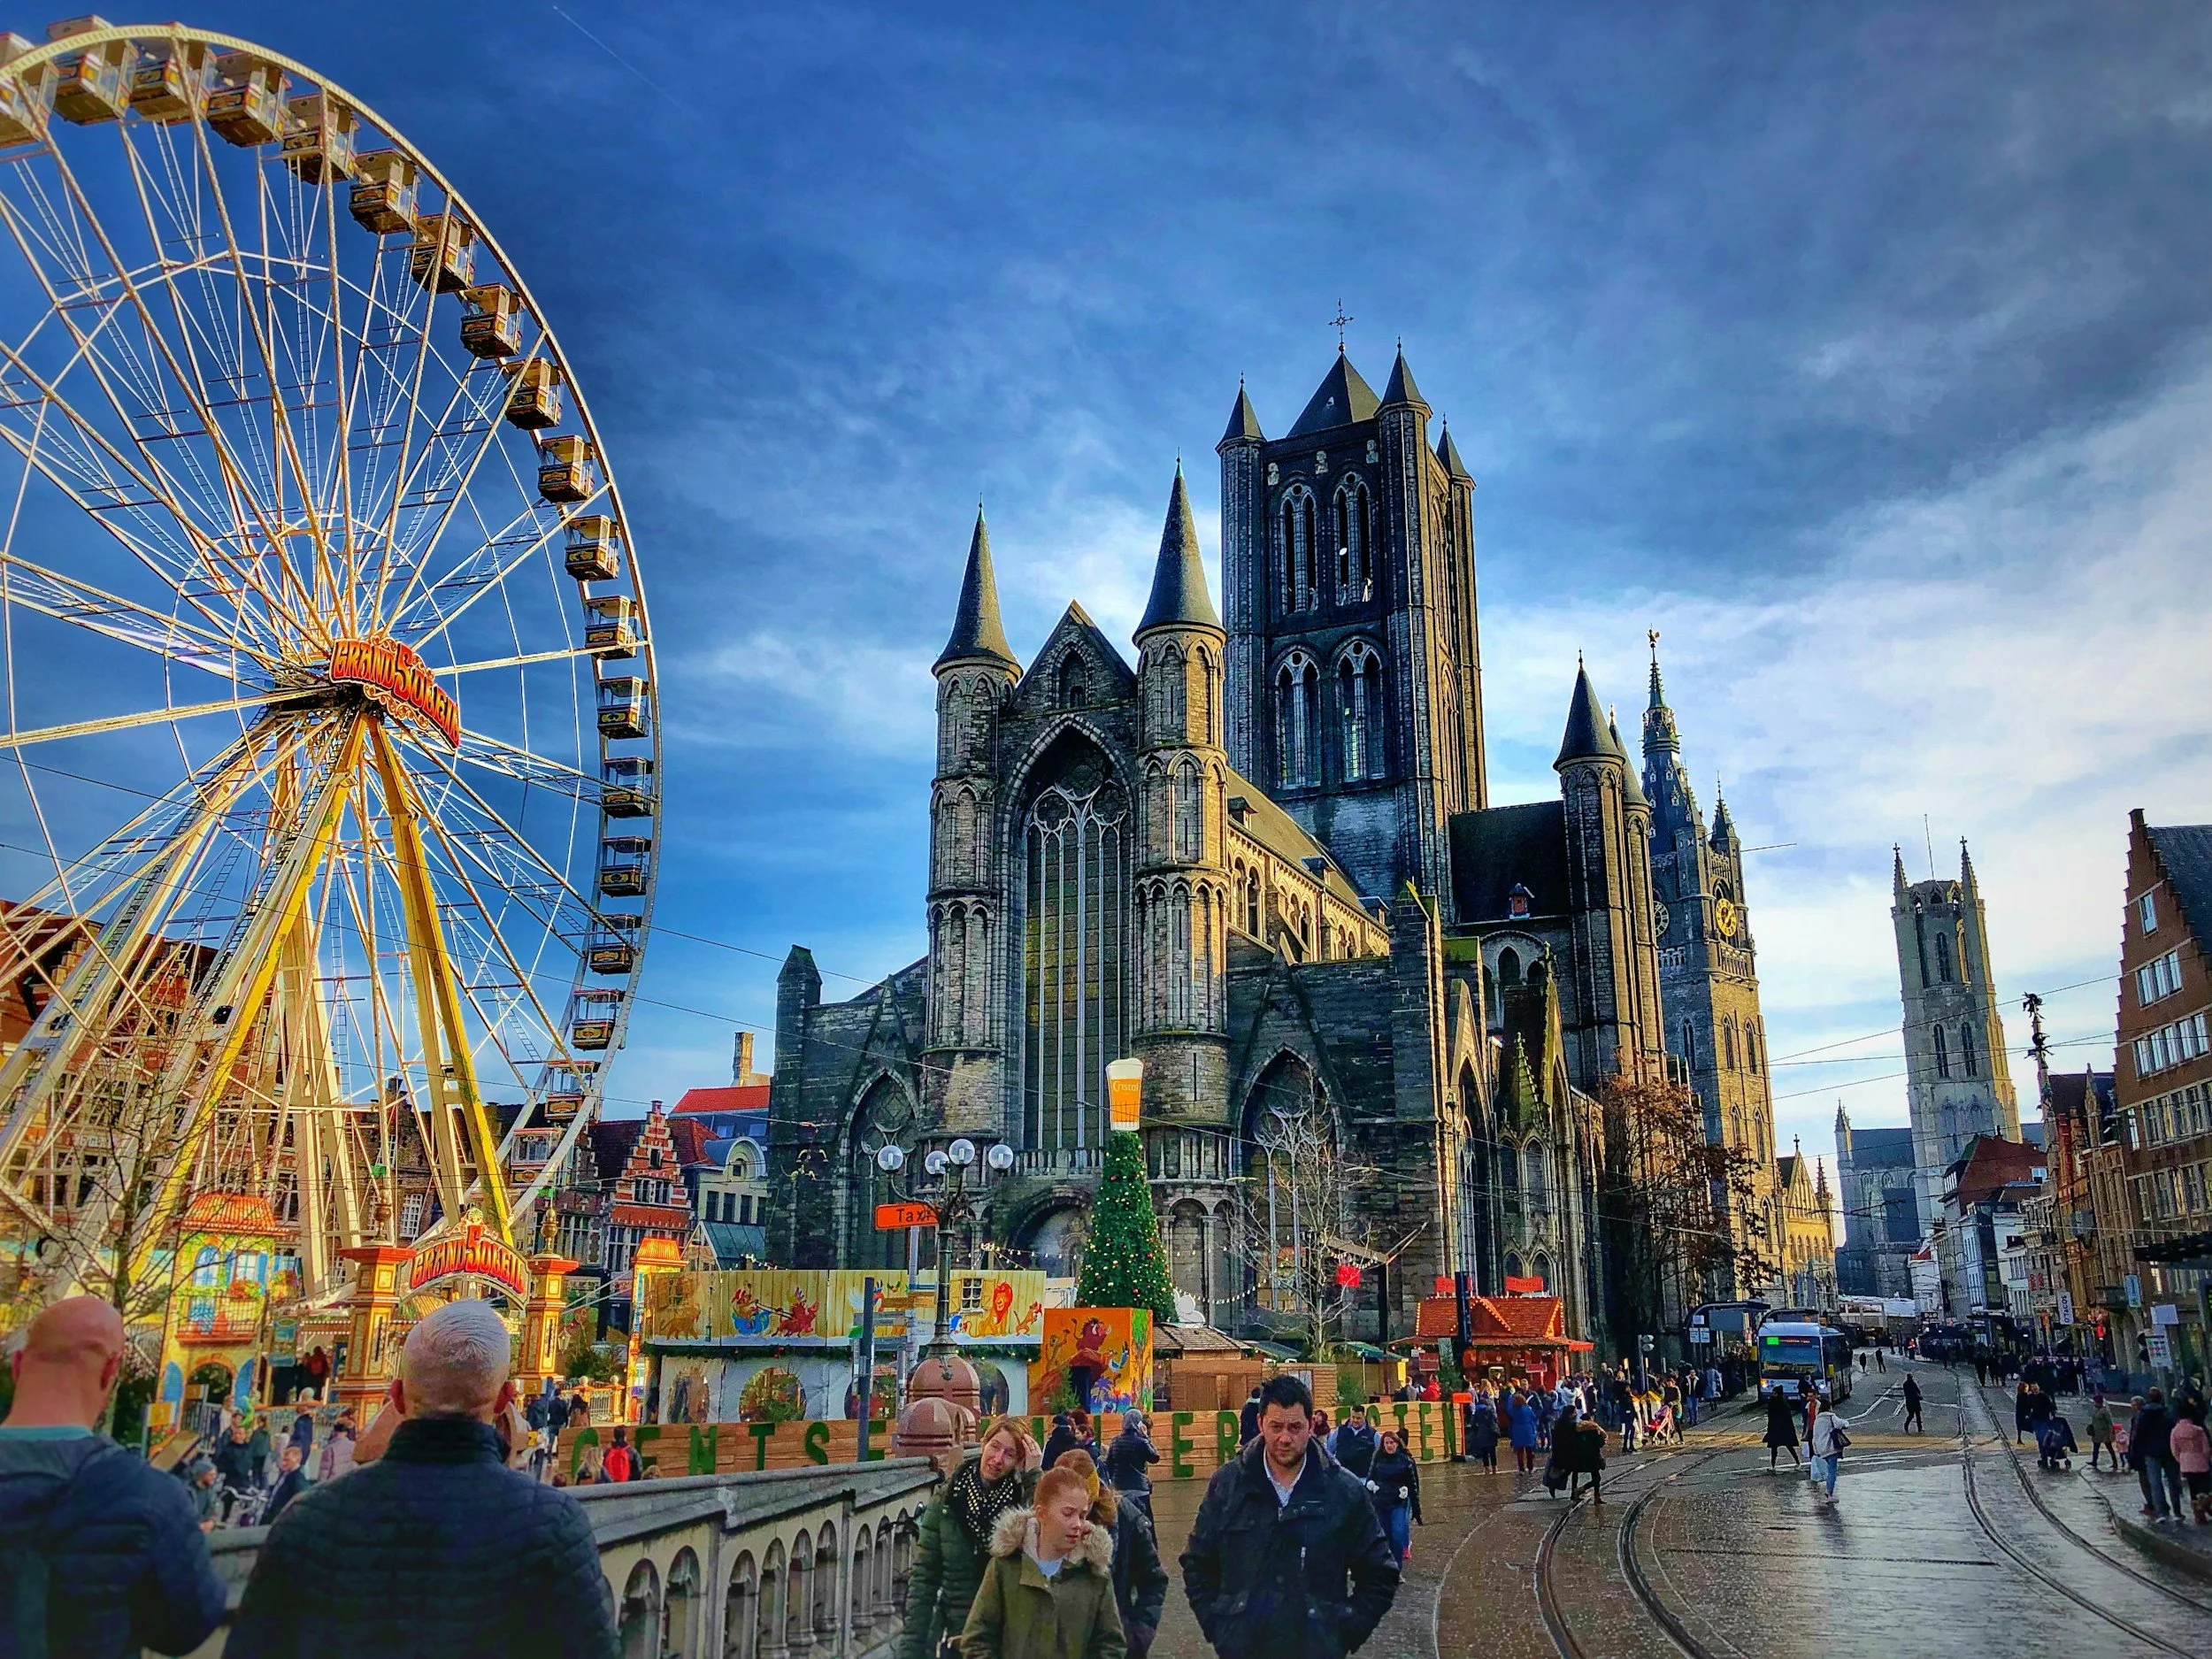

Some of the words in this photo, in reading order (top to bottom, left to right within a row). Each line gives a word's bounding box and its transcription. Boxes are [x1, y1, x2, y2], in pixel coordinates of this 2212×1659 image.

[334, 641, 396, 689] GRAND
[1112, 1080, 1139, 1093] Cristal
[410, 1238, 466, 1289] GRAND
[465, 1225, 525, 1294] SOLEIL
